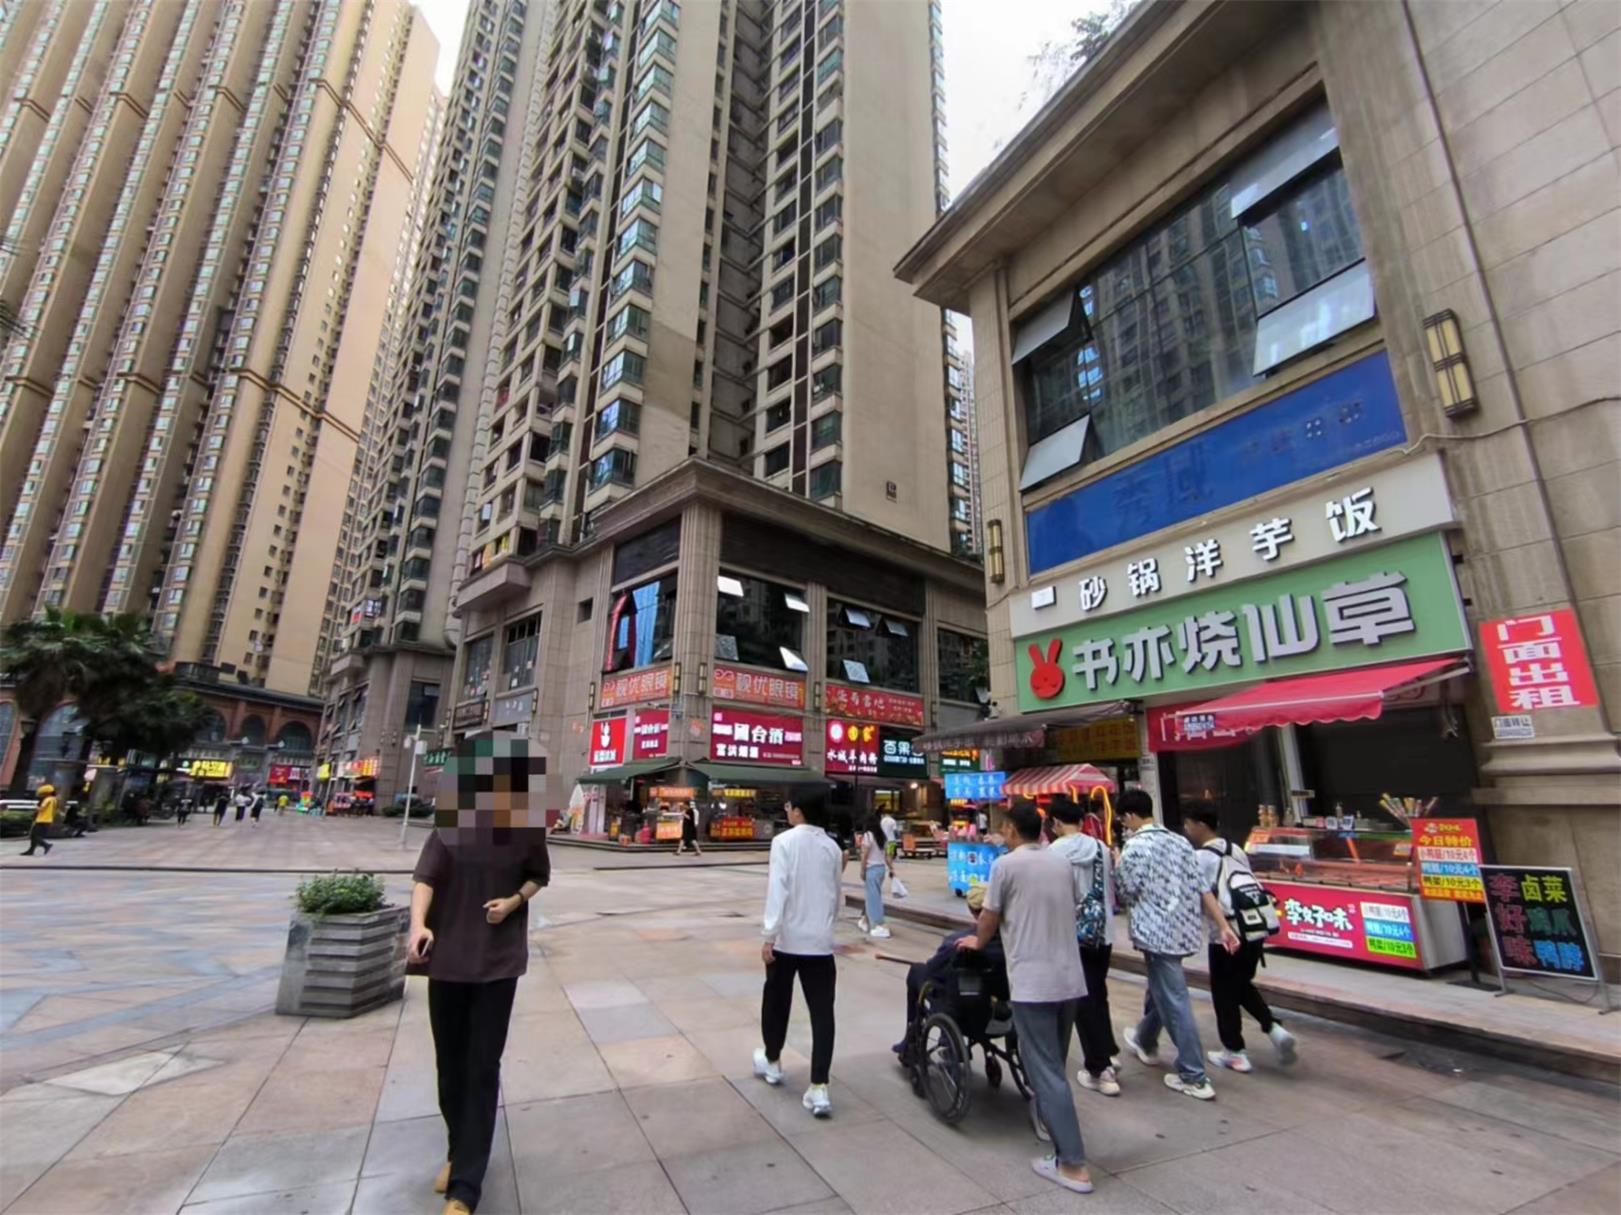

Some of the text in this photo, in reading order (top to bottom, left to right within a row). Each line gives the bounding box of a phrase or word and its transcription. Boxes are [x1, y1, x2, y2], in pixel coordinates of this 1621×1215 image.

[1079, 486, 1383, 612] 砂锅洋芋饭
[1072, 572, 1415, 690] 书亦烧仙草
[1497, 614, 1581, 709] 门面出租
[1418, 834, 1472, 848] 今日特价
[1284, 897, 1354, 931] 李好味
[1520, 873, 1568, 903] 卤菜
